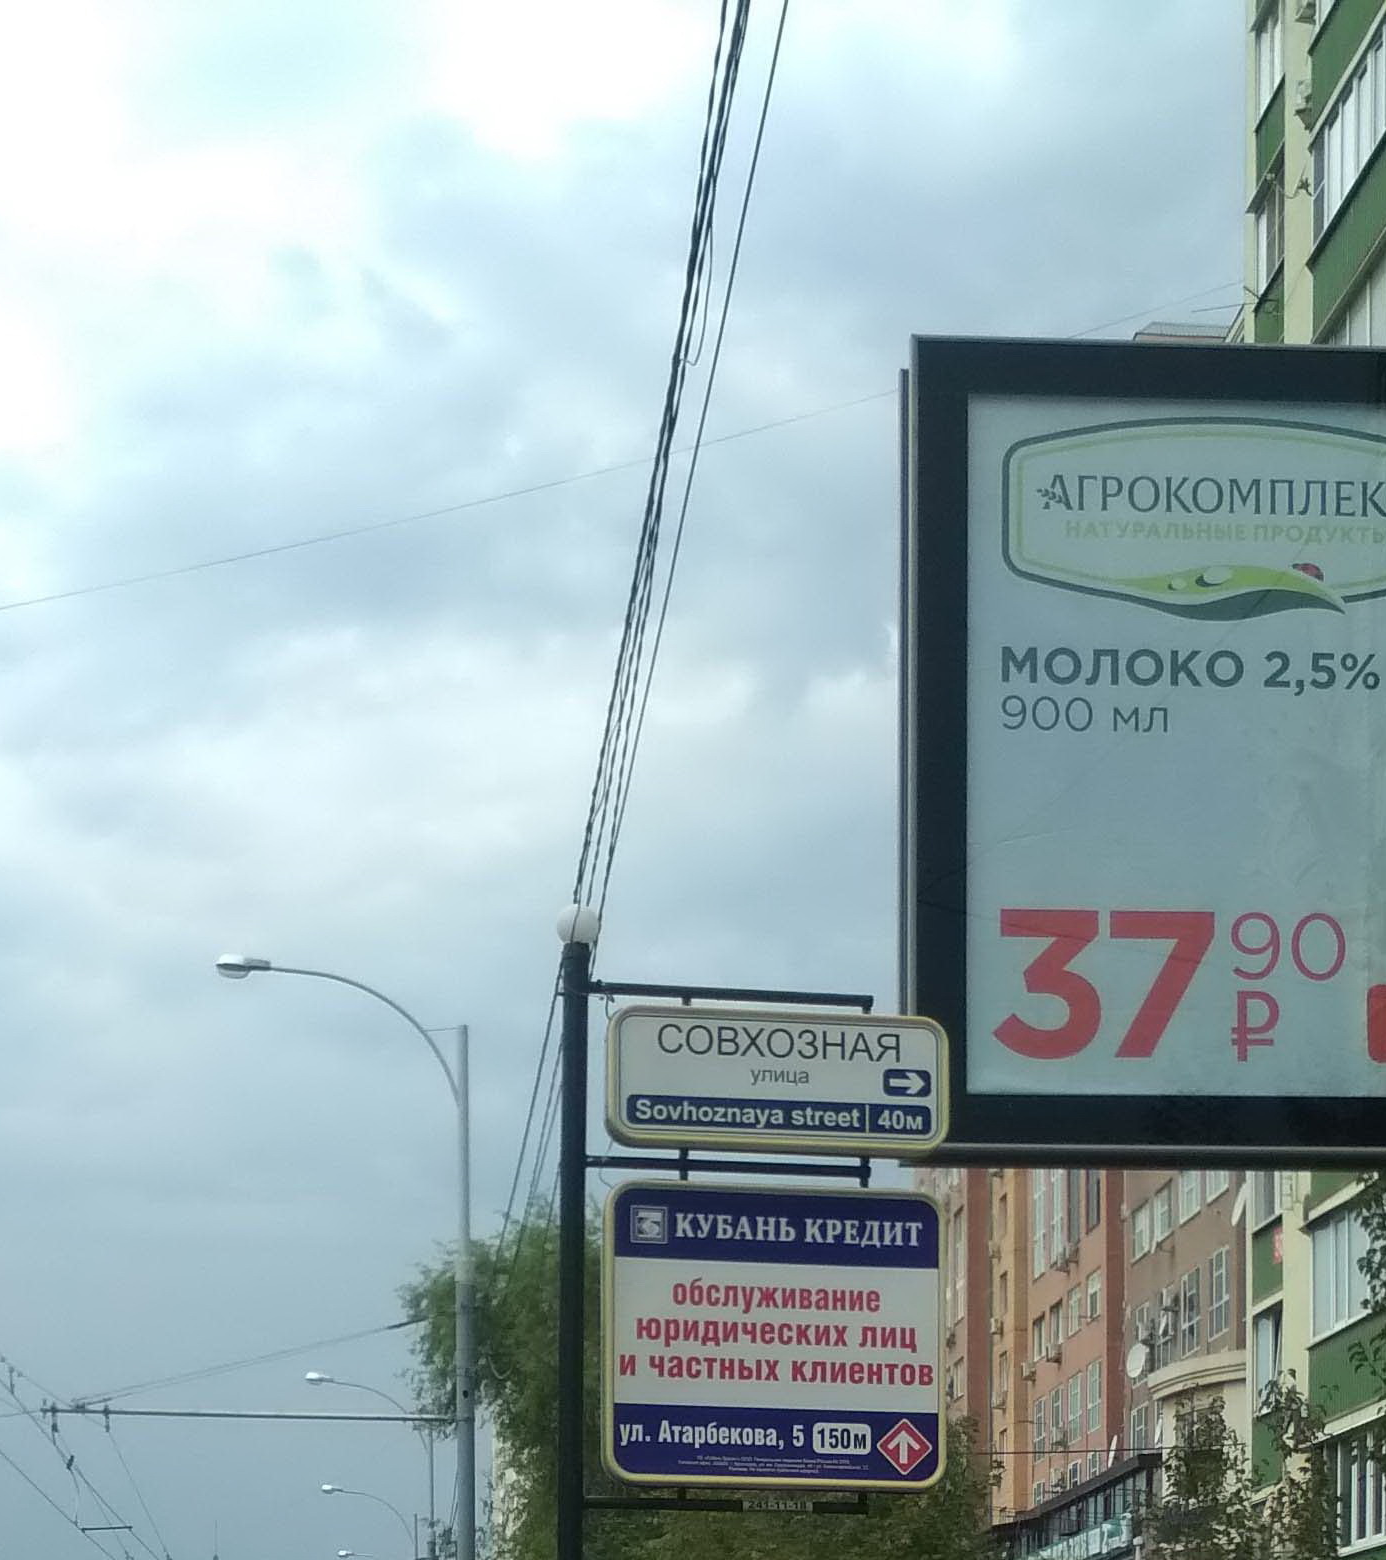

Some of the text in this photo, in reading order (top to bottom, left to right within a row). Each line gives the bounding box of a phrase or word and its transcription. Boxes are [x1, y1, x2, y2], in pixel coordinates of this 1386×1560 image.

[1066, 518, 1247, 543] НАТУРАЛЬНЫЕ
[1001, 646, 1381, 696] МОЛОКО 2,5%
[1001, 694, 1170, 733] 900 мл
[992, 908, 1346, 1060] 37 90
[657, 1023, 902, 1063] СОВХОЗНАЯ
[750, 1067, 810, 1086] улица
[635, 1099, 861, 1129] Sovhoznaya street
[675, 1211, 923, 1248] КУБАНЬ КРЕДИТ
[671, 1276, 882, 1314] обслуживание
[635, 1317, 918, 1354] юридических лиц
[618, 1353, 934, 1387] и частных клиентов
[619, 1419, 806, 1450] ул. Атарбекова, 5
[816, 1427, 868, 1450] 150м
